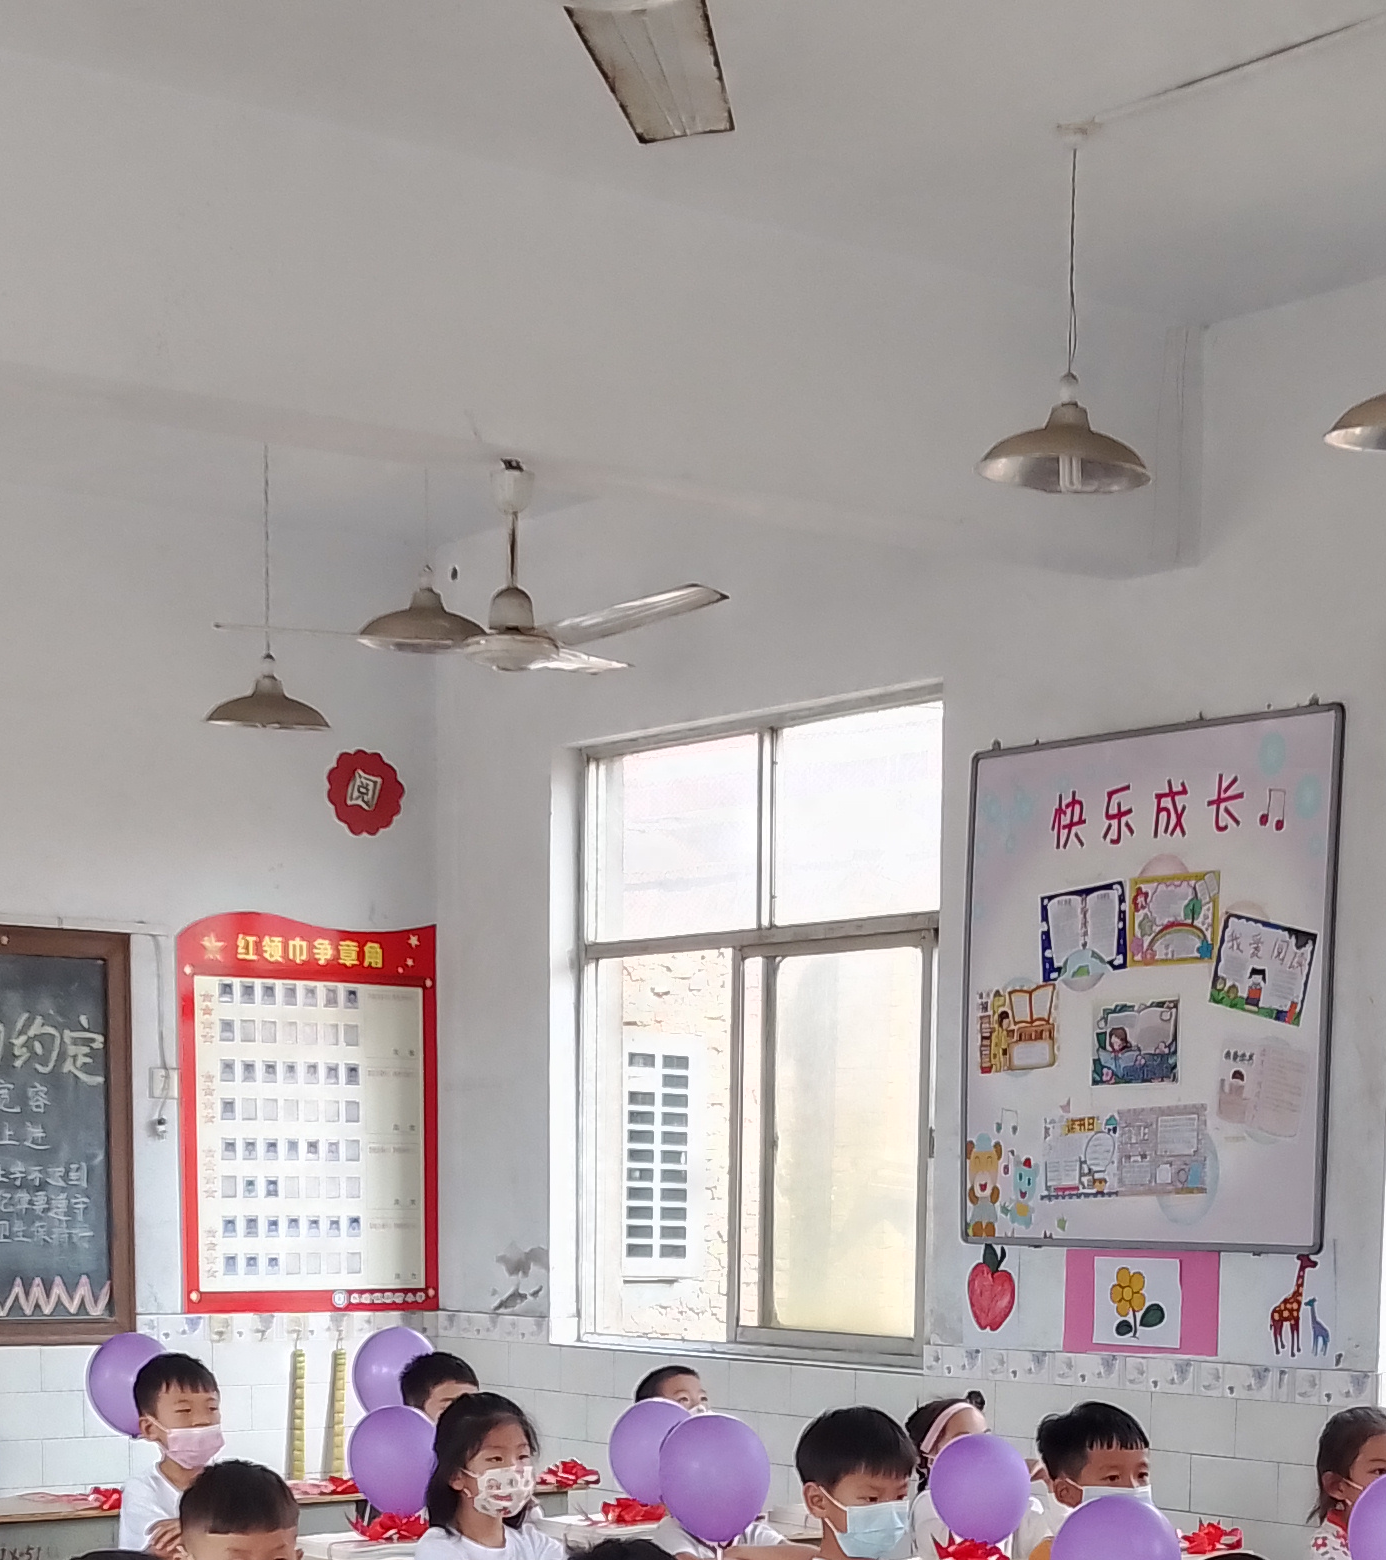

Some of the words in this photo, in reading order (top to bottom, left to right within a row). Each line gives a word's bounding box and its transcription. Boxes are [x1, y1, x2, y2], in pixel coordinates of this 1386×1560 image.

[1050, 772, 1245, 850] 快乐成长
[236, 934, 383, 968] 红领巾争章角
